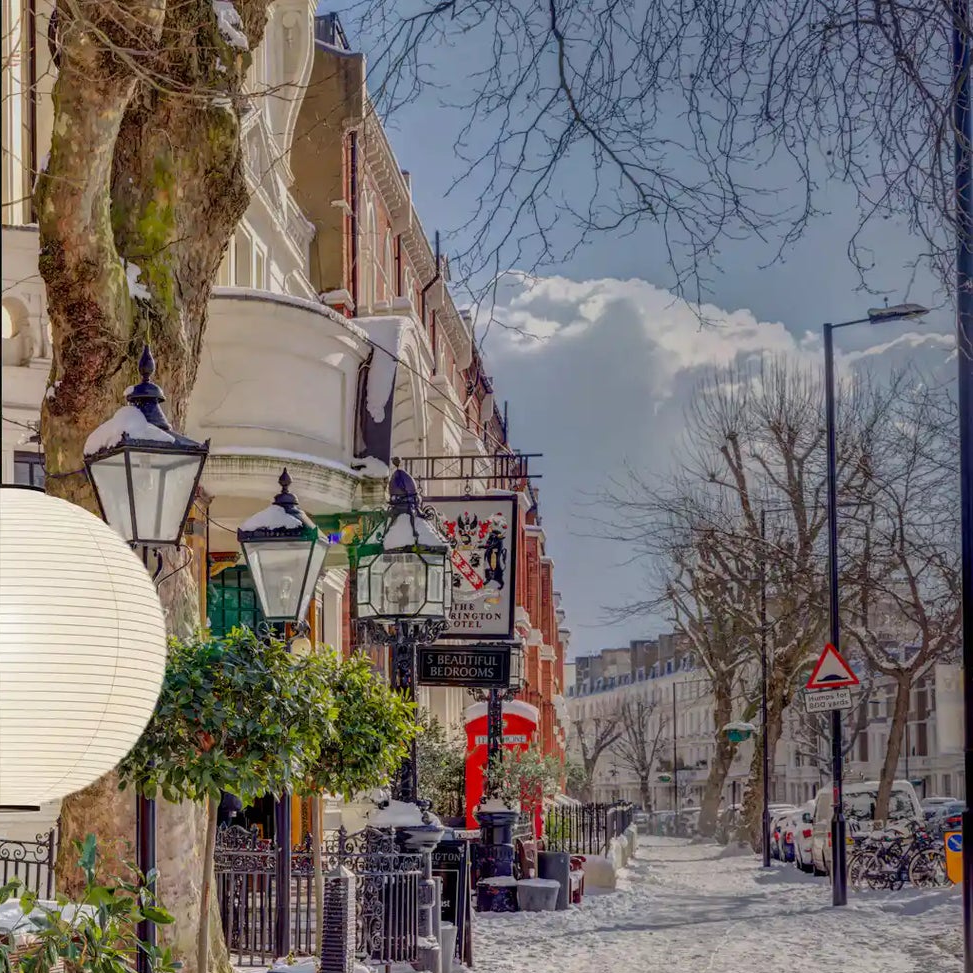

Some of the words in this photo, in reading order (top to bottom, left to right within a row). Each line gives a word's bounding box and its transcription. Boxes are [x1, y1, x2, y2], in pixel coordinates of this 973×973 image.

[454, 603, 475, 611] THE
[437, 655, 498, 666] BEAUTIFUL
[430, 666, 494, 678] BEDROOMS
